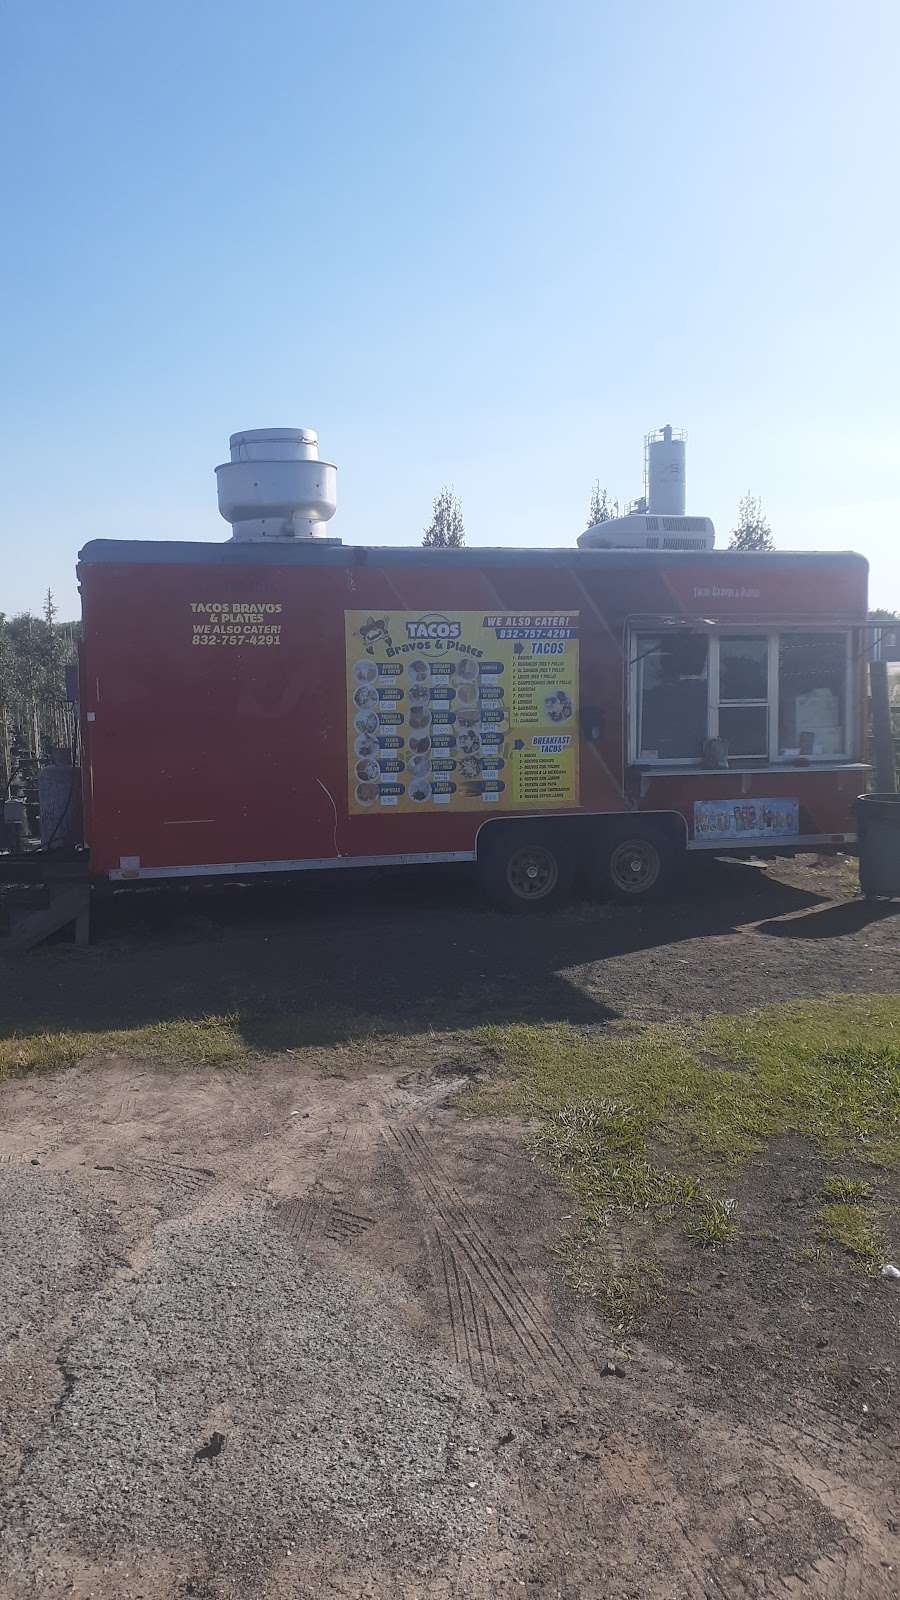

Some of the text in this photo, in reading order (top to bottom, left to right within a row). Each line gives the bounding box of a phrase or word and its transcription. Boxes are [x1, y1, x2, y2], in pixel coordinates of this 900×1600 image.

[190, 602, 282, 613] TACOS BRAVOS
[210, 614, 264, 622] & PLATES
[487, 617, 570, 626] WE ALSO CATER!
[192, 625, 281, 634] WE ALSO CATER!
[407, 624, 460, 637] TACOS
[500, 629, 571, 638] 832-757-4291
[192, 635, 280, 646] 832-757-4291
[386, 640, 484, 658] Bravos & Plates
[531, 642, 564, 654] TACOS
[533, 736, 570, 745] BREAKFAST
